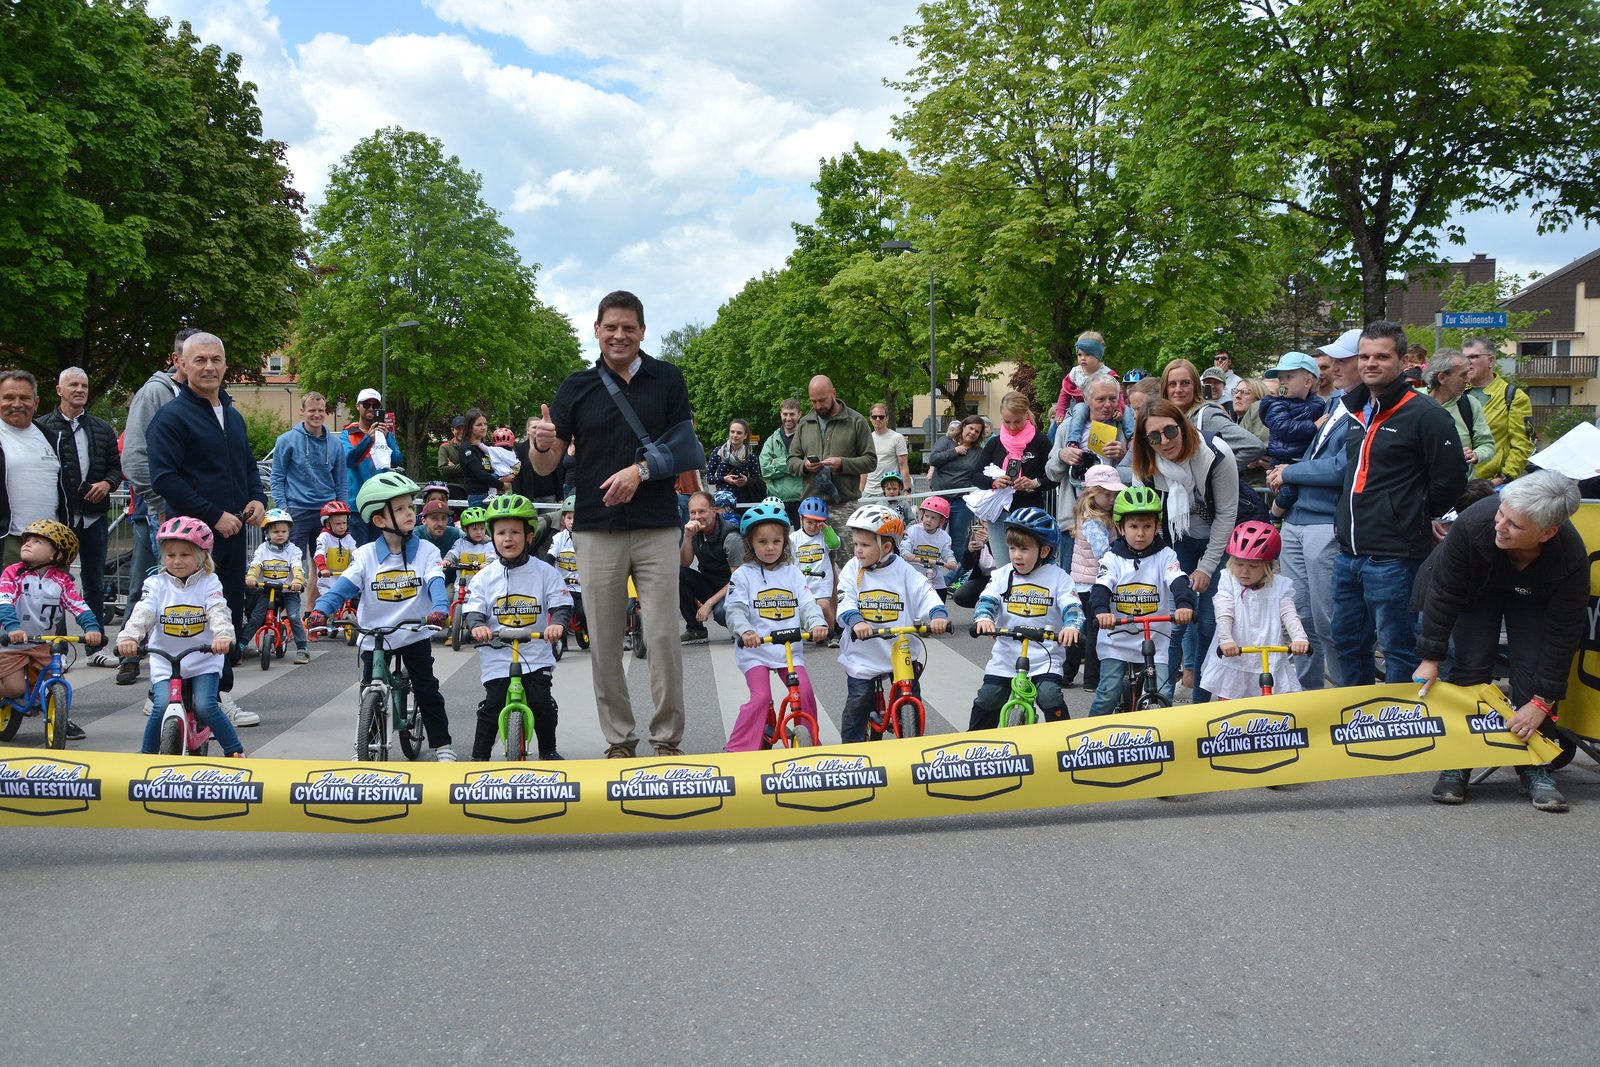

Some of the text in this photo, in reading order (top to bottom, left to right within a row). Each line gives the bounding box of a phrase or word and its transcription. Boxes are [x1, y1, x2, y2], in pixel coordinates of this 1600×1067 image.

[1445, 314, 1504, 324] Zur Salinenstr. 4
[372, 582, 396, 590] CYCLING
[755, 600, 776, 608] CYCLING
[879, 602, 902, 610] FESTIVAL
[1028, 596, 1052, 605] FESTIVAL
[161, 616, 184, 624] CYCLING
[1348, 704, 1422, 730] Jan Ullrich
[1471, 718, 1507, 730] CYCL
[1215, 716, 1290, 742] Jan Ullrich
[1334, 720, 1442, 742] CYCLING FESTIVAL
[1076, 730, 1154, 756] Jan Ullrich
[1201, 732, 1306, 756] CYCLING FESTIVAL
[931, 744, 1012, 769] Jan Ullrich
[1062, 744, 1170, 768] CYCLING FESTIVAL
[25, 764, 81, 781] Ullrich
[628, 767, 714, 785] Jan Ullrich
[782, 757, 865, 779] Jan Ullrich
[916, 758, 1030, 781] CYCLING FESTIVAL
[152, 768, 244, 788] Jan Ullrich
[313, 772, 403, 789] Jan Ullrich
[472, 772, 560, 789] Jan Ullrich
[766, 771, 882, 791] CYCLING FESTIVAL
[0, 781, 96, 798] LING FESTIVAL
[133, 783, 258, 800] CYCLING FESTIVAL
[295, 786, 418, 802] CYCLING FESTIVAL
[454, 784, 576, 801] CYCLING FESTIVAL
[612, 780, 731, 798] CYCLING FESTIVAL
